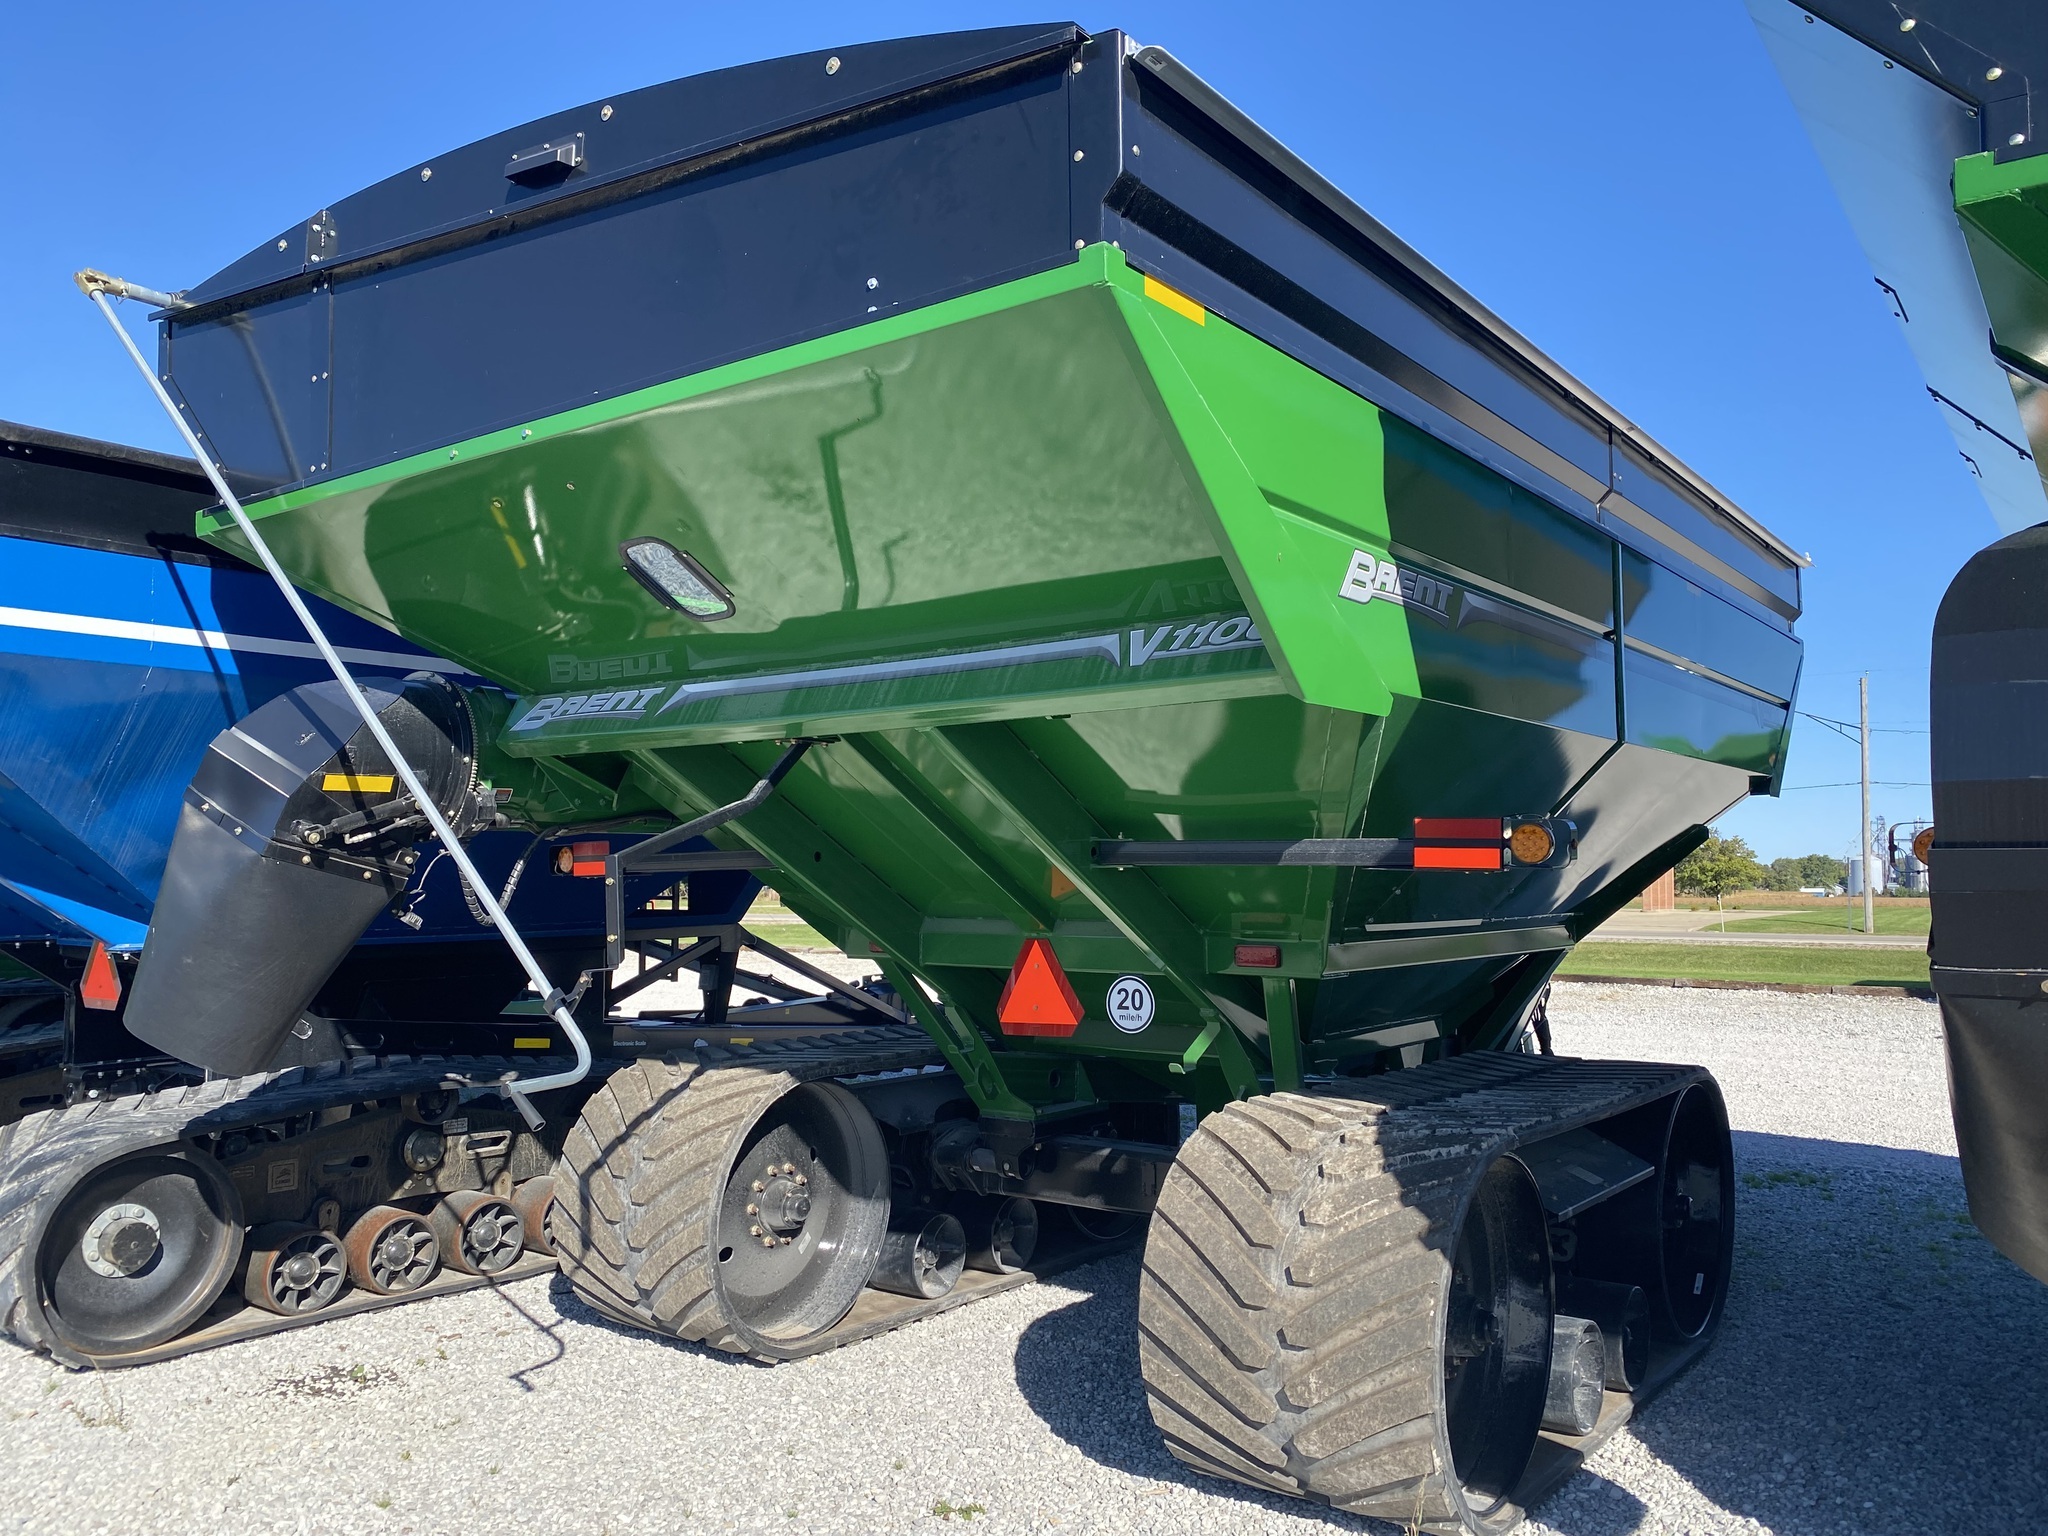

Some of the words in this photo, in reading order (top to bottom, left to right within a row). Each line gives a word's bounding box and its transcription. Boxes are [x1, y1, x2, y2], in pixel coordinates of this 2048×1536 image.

[1338, 549, 1454, 614] BRENT
[508, 687, 667, 732] BRENT
[1116, 987, 1144, 1011] 20
[1119, 1013, 1143, 1022] mile/h
